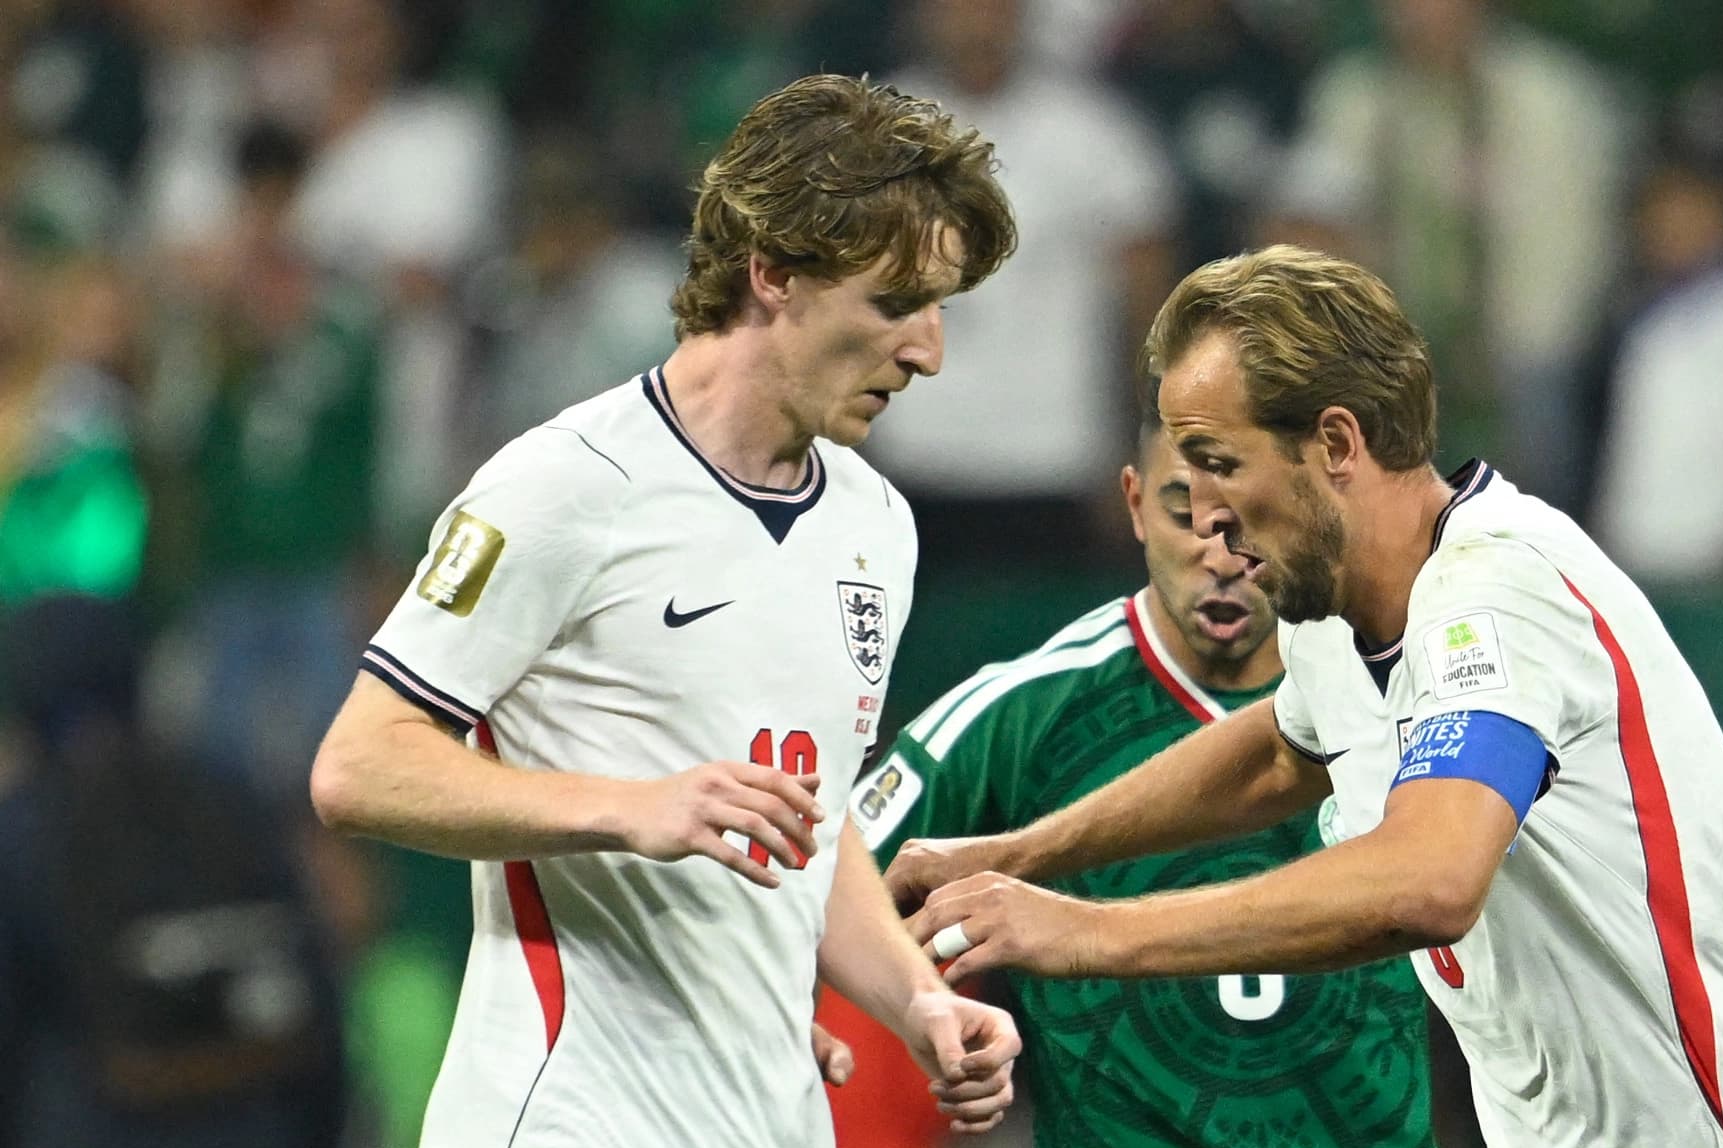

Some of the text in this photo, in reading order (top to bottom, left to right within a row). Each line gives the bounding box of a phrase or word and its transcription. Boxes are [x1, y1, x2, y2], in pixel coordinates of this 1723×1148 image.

[1442, 662, 1496, 684] EDUCATION
[1459, 679, 1481, 689] FIFA
[1409, 740, 1466, 764] World
[1401, 764, 1428, 778] FIFA
